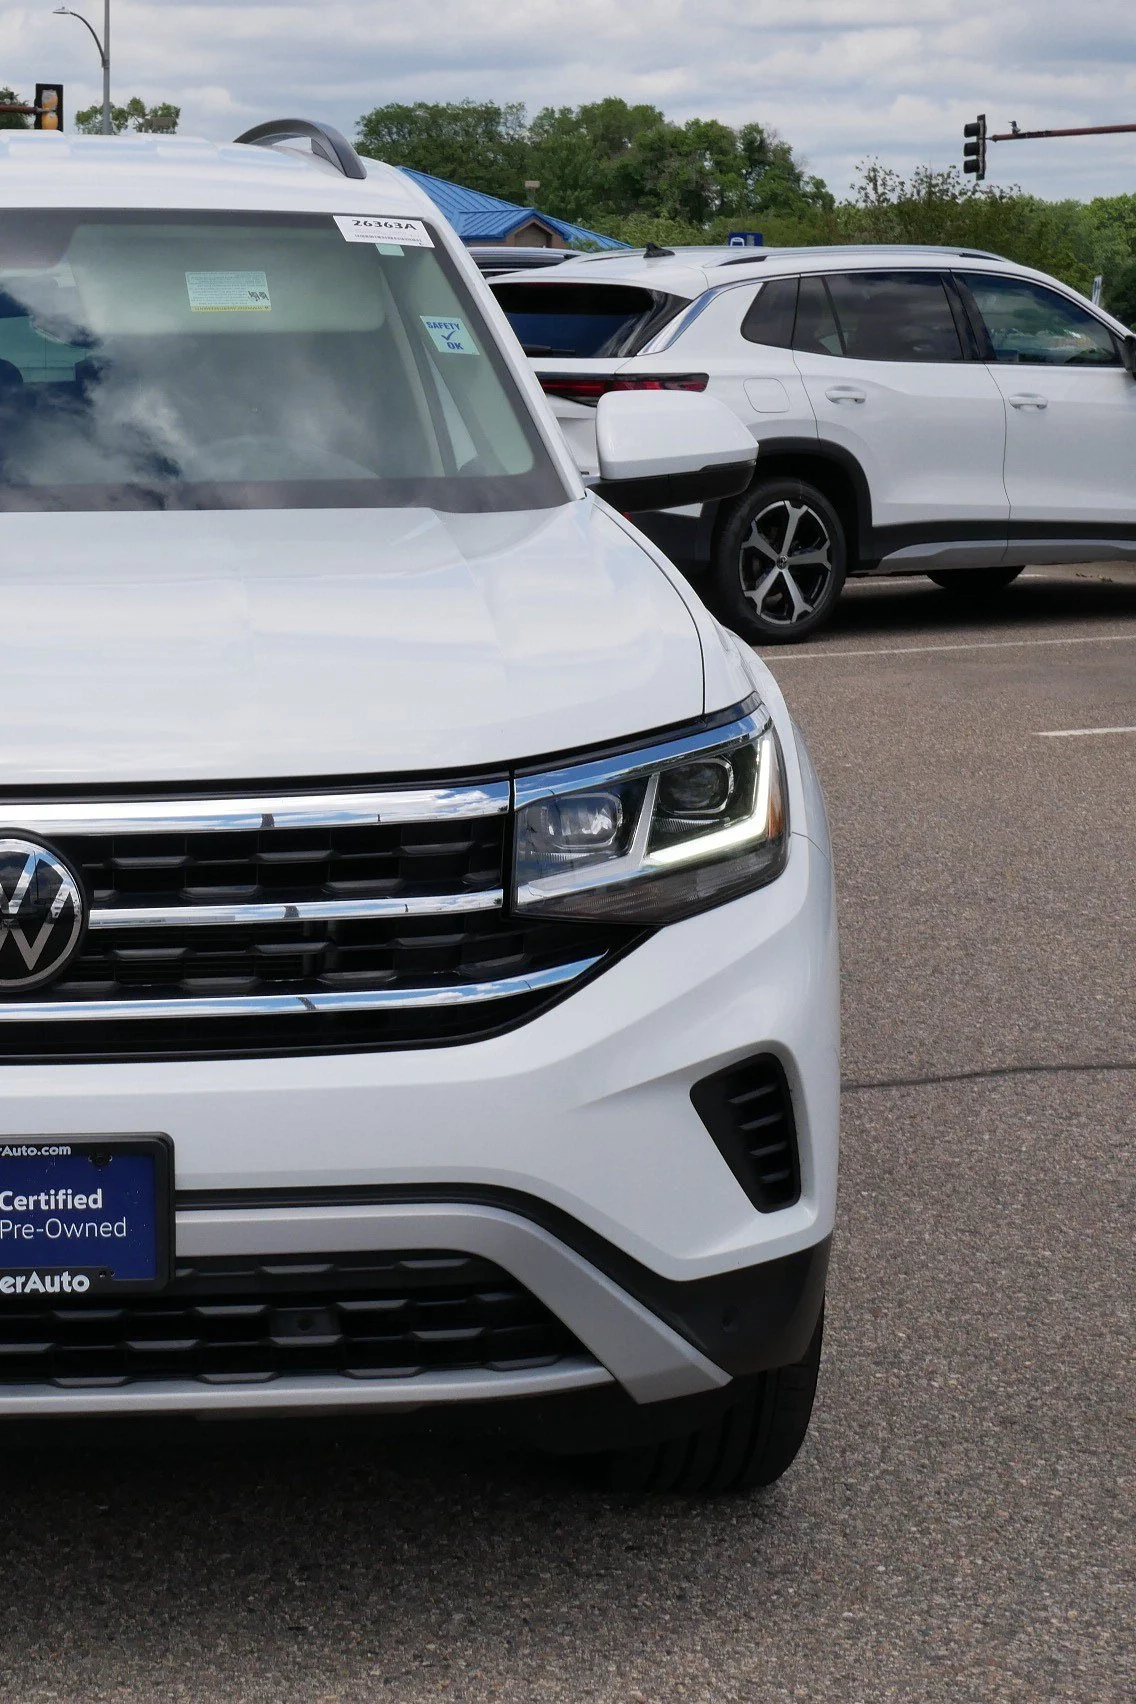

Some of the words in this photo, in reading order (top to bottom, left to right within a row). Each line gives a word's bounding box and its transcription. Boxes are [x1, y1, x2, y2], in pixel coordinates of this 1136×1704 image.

[352, 219, 418, 231] 26363A
[426, 321, 461, 331] SAFETY
[447, 341, 464, 350] OK
[0, 1216, 127, 1240] Pre-Owned
